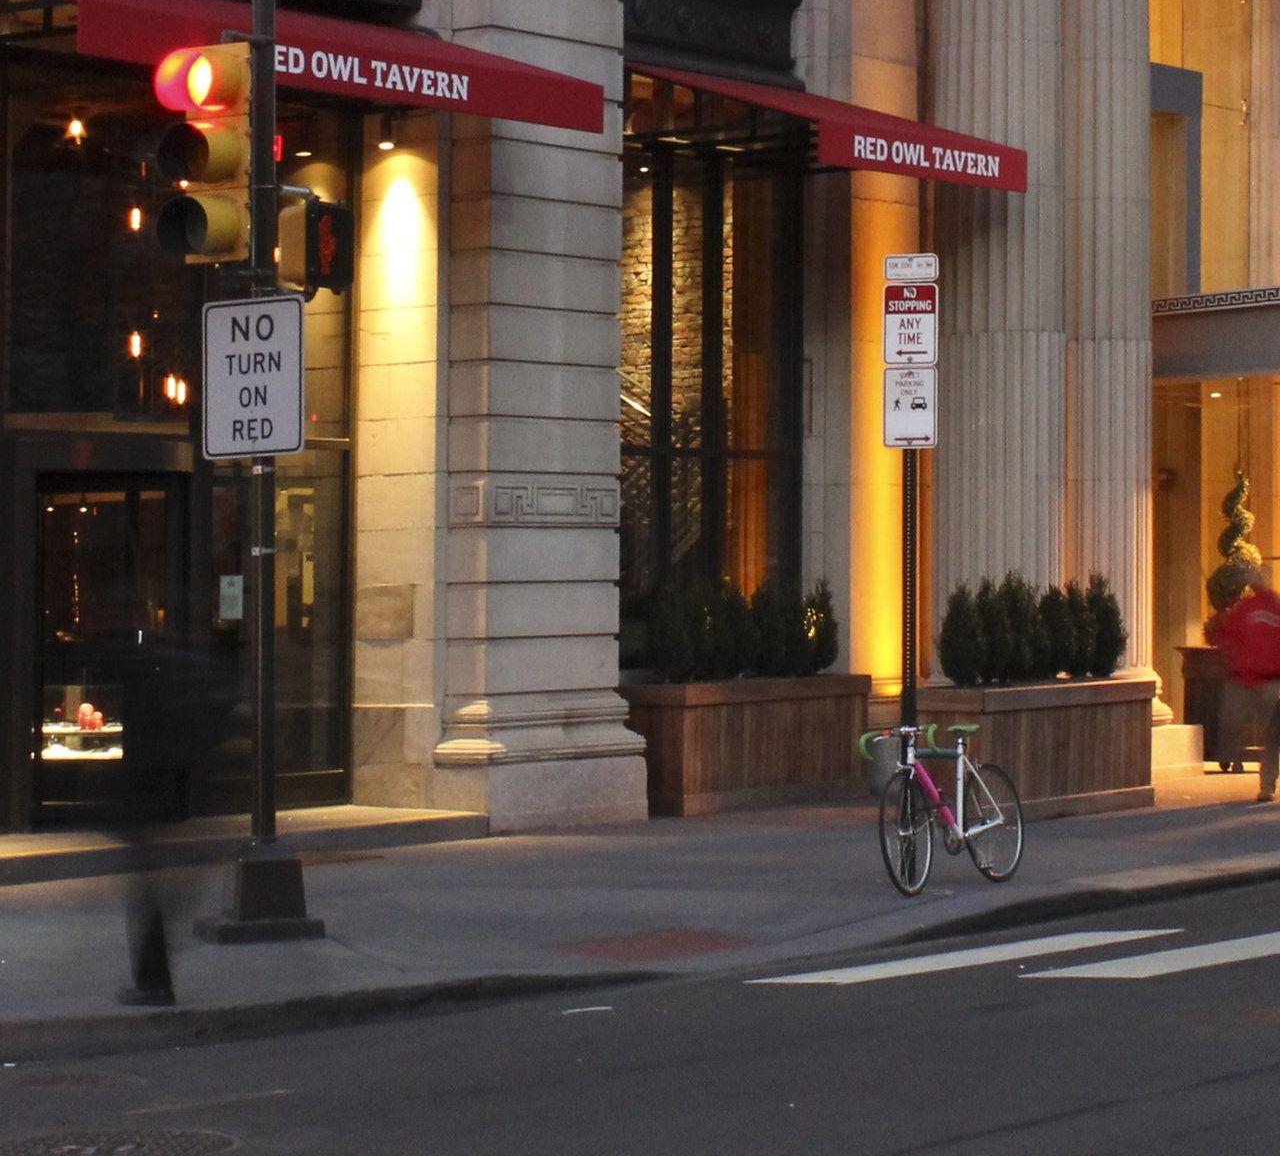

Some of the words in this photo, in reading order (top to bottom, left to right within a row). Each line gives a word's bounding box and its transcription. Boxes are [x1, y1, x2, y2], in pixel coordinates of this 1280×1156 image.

[274, 44, 305, 74] ED
[311, 50, 368, 84] OWL
[371, 60, 469, 101] TAVERN
[853, 135, 888, 162] RED
[891, 140, 930, 167] OWL
[932, 146, 1000, 178] TAVERN
[903, 287, 917, 299] NO
[888, 300, 933, 312] STOPPING
[231, 314, 274, 342] NO
[898, 318, 922, 330] ANY
[897, 332, 923, 345] TIME
[225, 351, 281, 376] TURN
[239, 385, 267, 408] ON
[232, 418, 273, 442] RED
